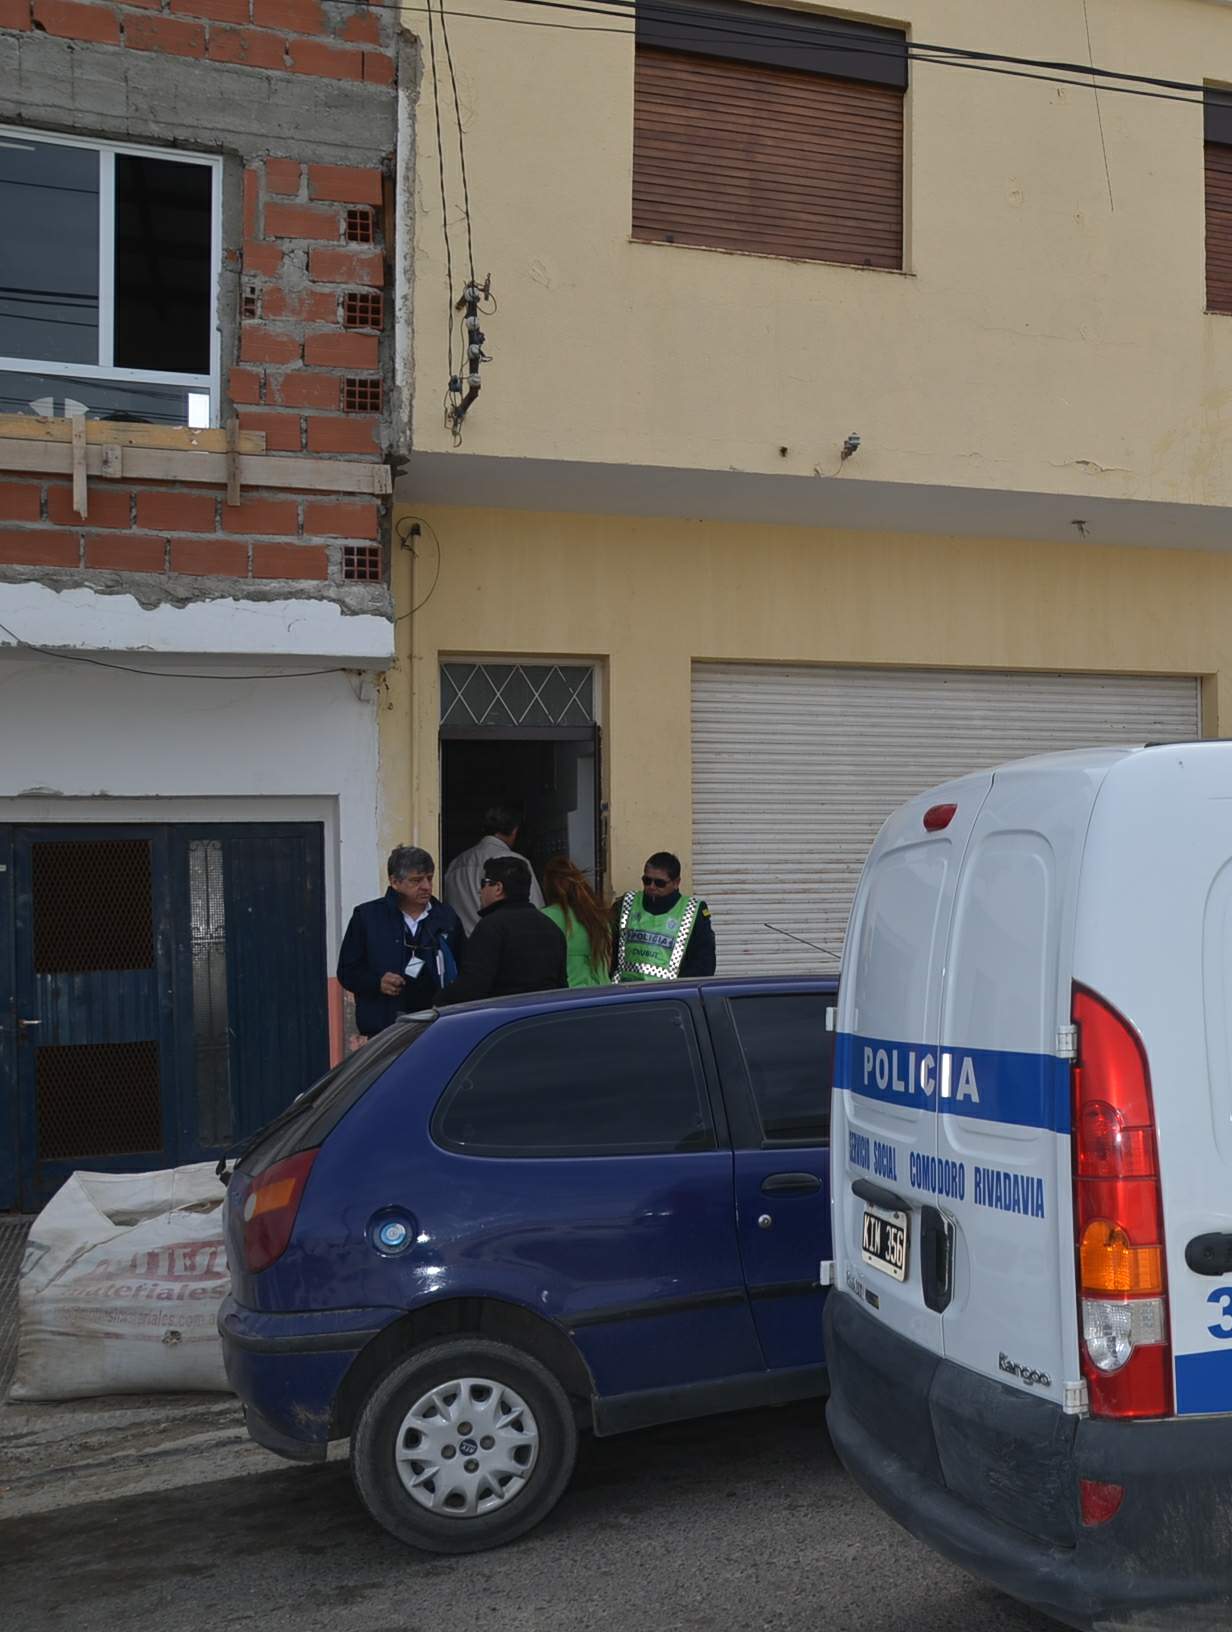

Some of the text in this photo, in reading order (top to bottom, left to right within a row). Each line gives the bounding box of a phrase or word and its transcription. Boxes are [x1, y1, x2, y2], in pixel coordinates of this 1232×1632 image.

[864, 1047, 979, 1103] POLICIA
[849, 1130, 1046, 1219] SERVICIO SOCIAL COMODORO RIVADAVIA
[885, 1225, 904, 1267] 356
[999, 1351, 1052, 1387] Kangoo
